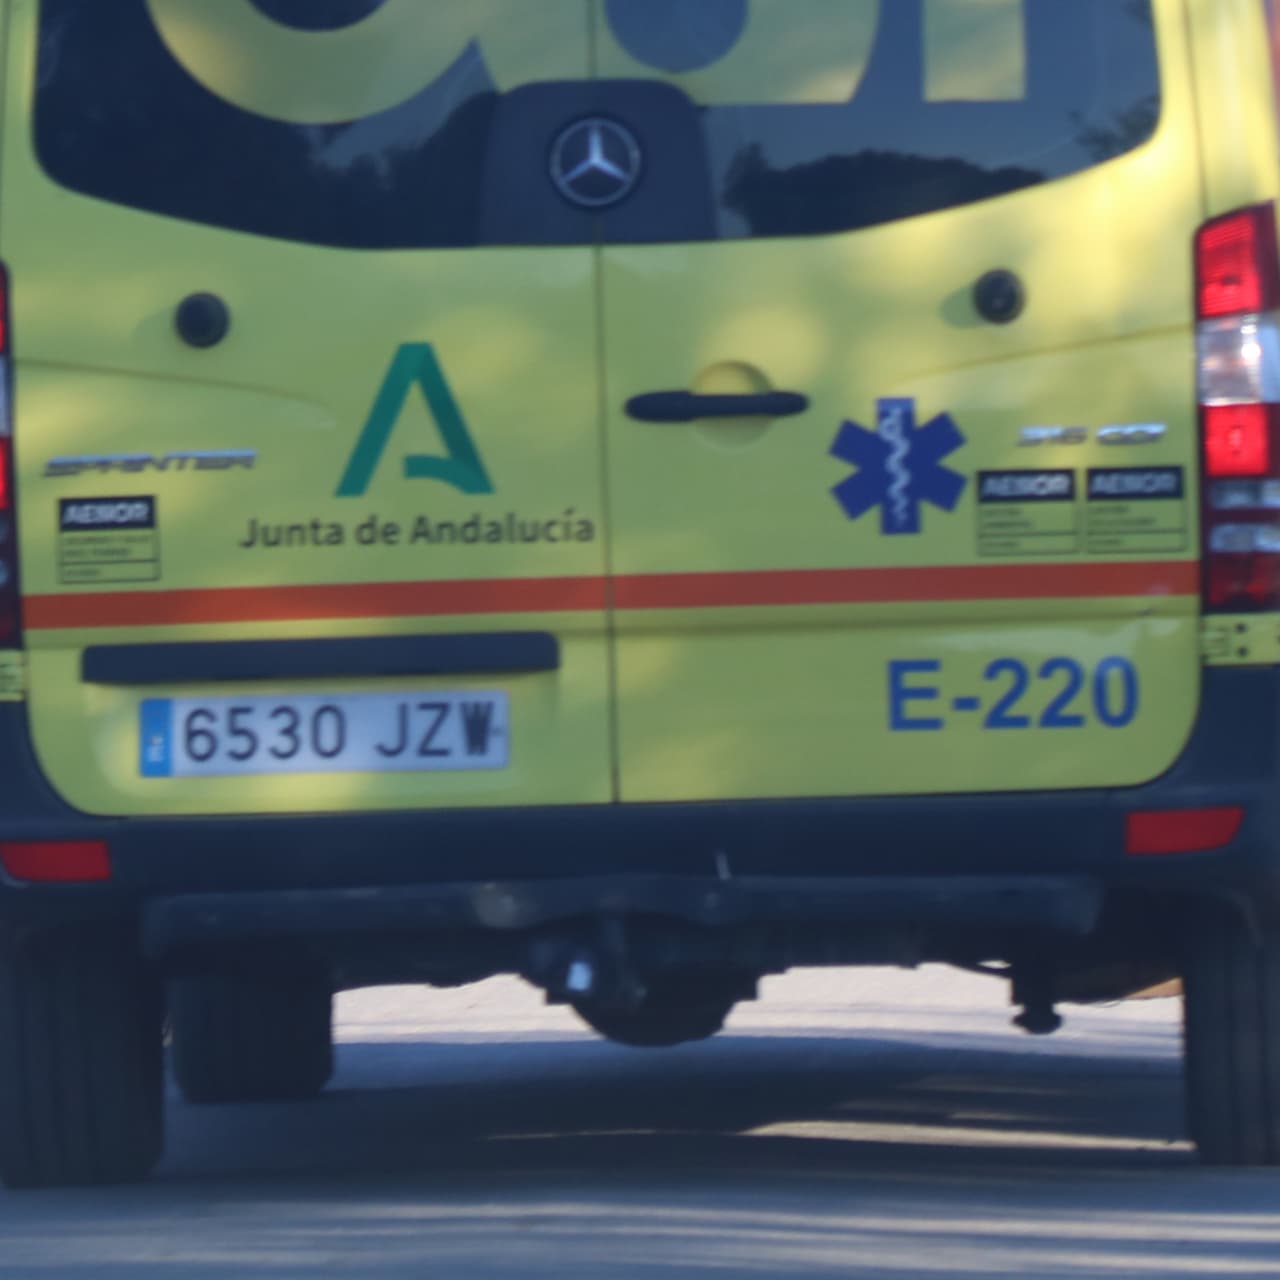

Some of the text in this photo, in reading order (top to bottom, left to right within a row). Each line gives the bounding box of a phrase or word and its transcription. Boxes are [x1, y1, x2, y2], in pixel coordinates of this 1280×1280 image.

[238, 504, 596, 549] Junta de Andalucía
[886, 655, 1139, 732] E-220
[183, 699, 496, 763] 6530 JZW
